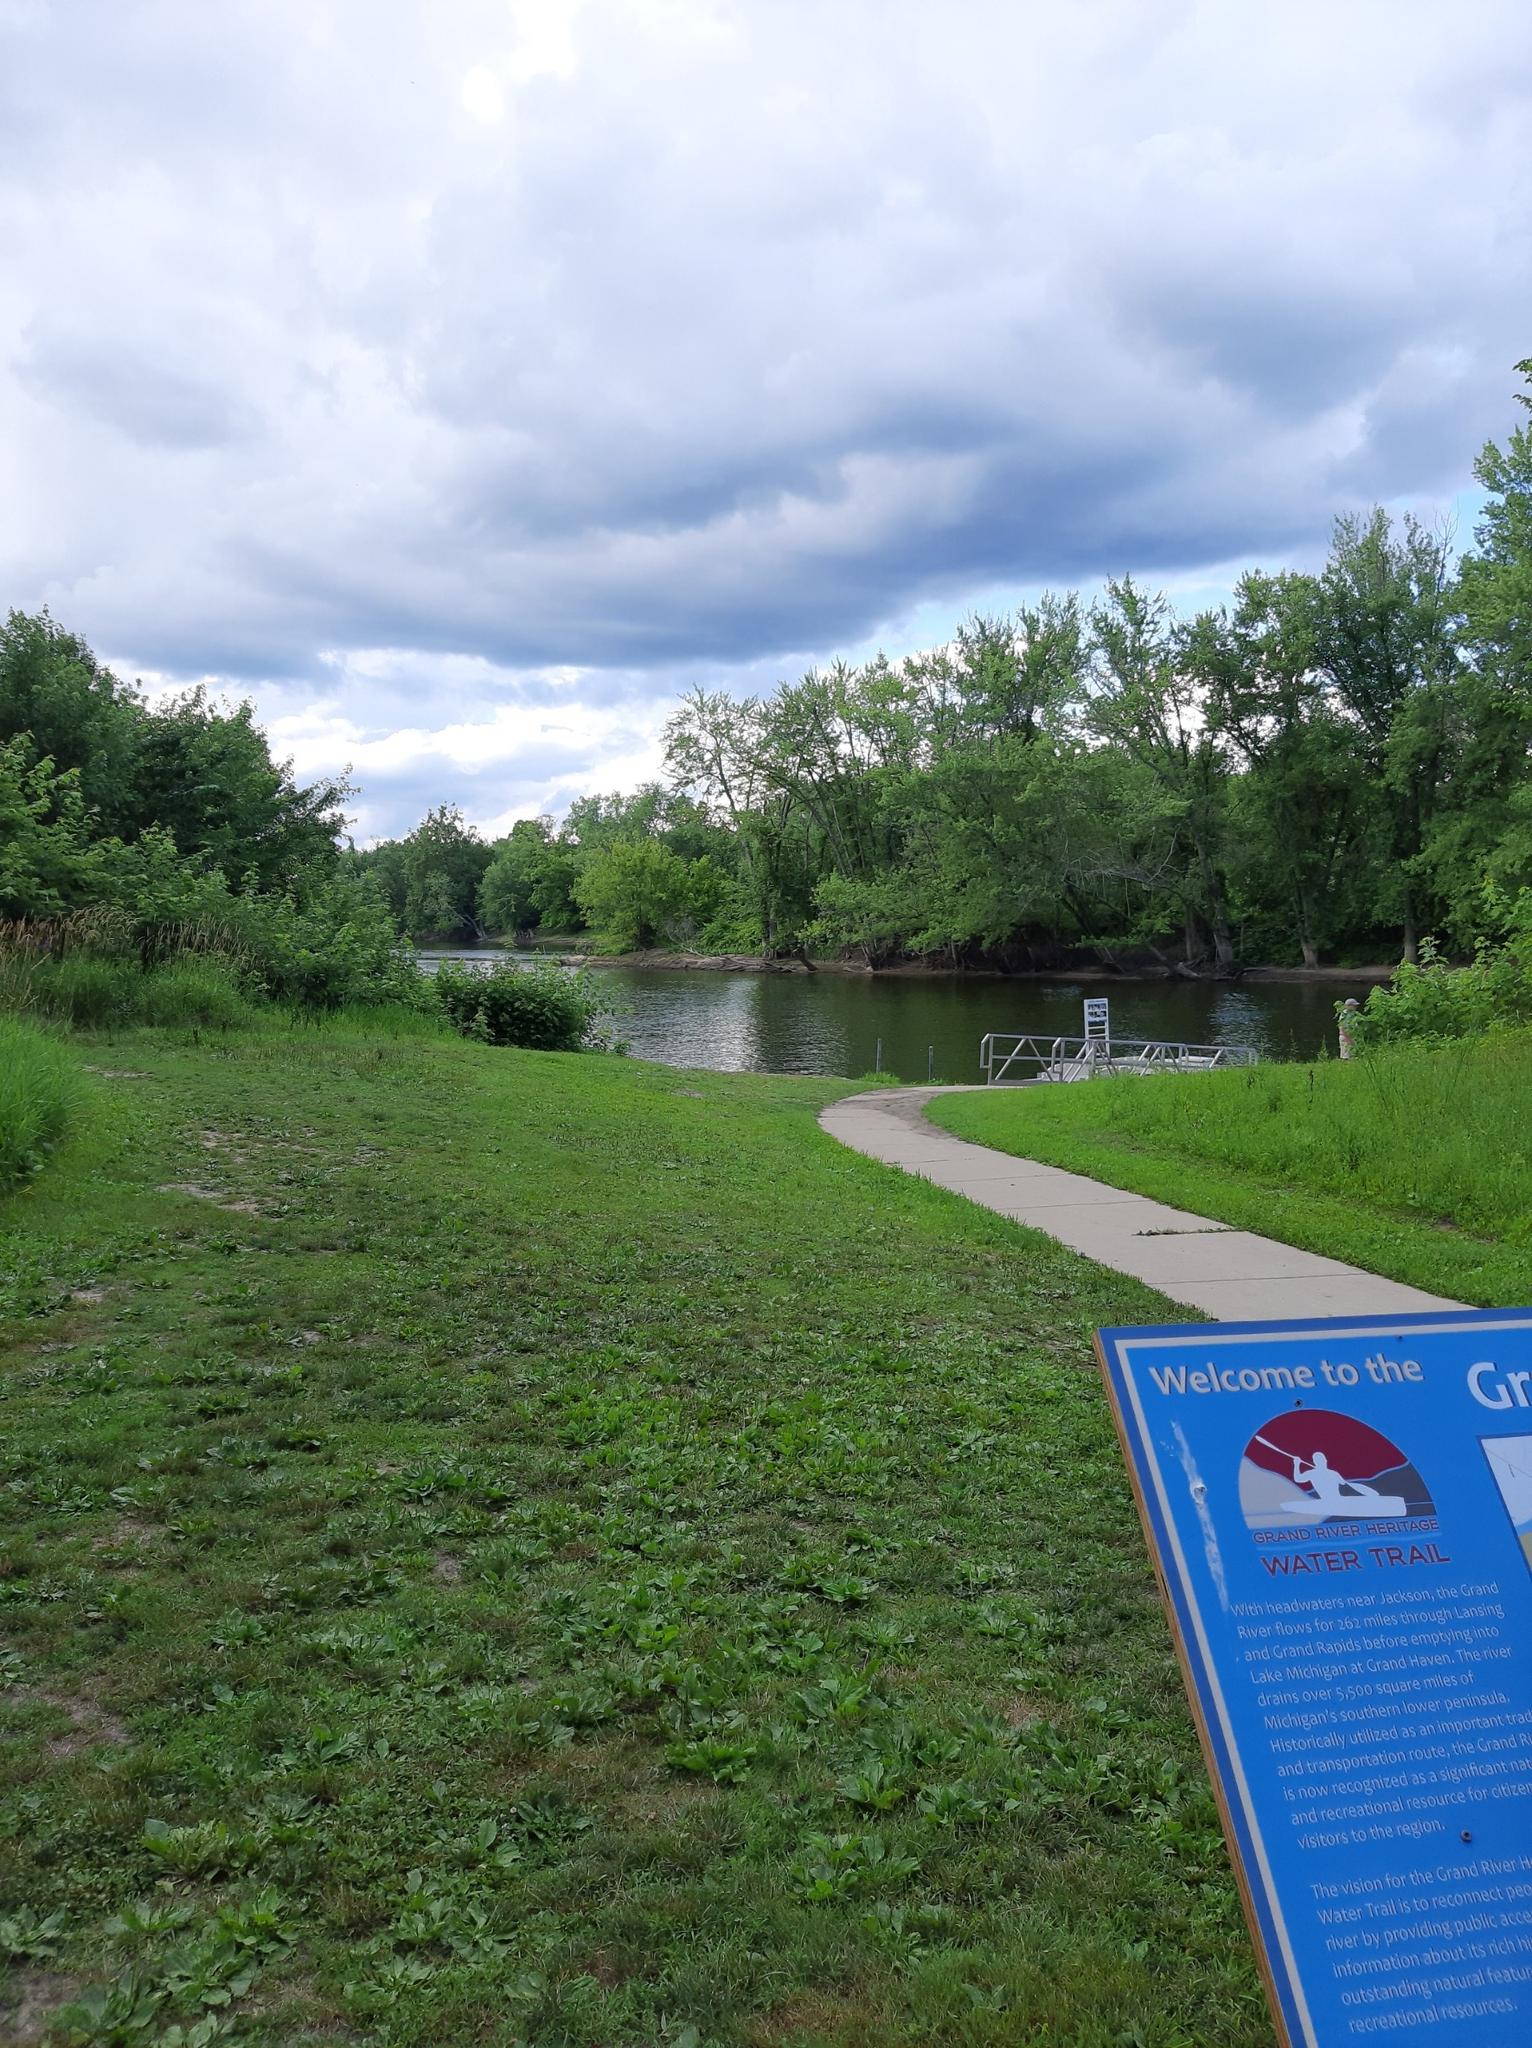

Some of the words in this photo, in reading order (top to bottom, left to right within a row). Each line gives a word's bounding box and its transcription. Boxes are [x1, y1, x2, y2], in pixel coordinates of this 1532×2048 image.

[1149, 1362, 1316, 1395] Welcome
[1321, 1360, 1359, 1386] to
[1366, 1353, 1424, 1384] the
[1467, 1361, 1532, 1409] Gr
[1253, 1529, 1310, 1543] GRAND
[1315, 1524, 1360, 1539] RIVER
[1367, 1518, 1440, 1535] HERITAGE
[1260, 1551, 1363, 1577] WATER
[1369, 1543, 1450, 1568] TRAIL
[1230, 1602, 1265, 1615] With
[1266, 1598, 1344, 1613] headwaters
[1347, 1596, 1375, 1606] near
[1381, 1589, 1435, 1604] Jackson,
[1436, 1586, 1458, 1599] the
[1461, 1582, 1499, 1596] Grand
[1237, 1626, 1272, 1638] River
[1275, 1622, 1312, 1635] flows
[1315, 1618, 1333, 1631] for
[1338, 1617, 1360, 1629] 262
[1364, 1615, 1400, 1626] miles
[1400, 1608, 1452, 1624] through
[1455, 1604, 1504, 1619] Lansing
[1245, 1645, 1270, 1661] and
[1273, 1642, 1314, 1658] Grand
[1317, 1640, 1361, 1656] Rapids
[1363, 1635, 1408, 1649] before
[1411, 1630, 1472, 1646] emptying
[1473, 1627, 1499, 1638] into
[1251, 1669, 1283, 1683] Lake
[1286, 1664, 1349, 1680] Michigan
[1351, 1663, 1364, 1673] at
[1367, 1656, 1407, 1671] Grand
[1409, 1655, 1454, 1666] Haven.
[1457, 1648, 1483, 1661] The
[1484, 1647, 1511, 1658] river
[1258, 1692, 1299, 1706] drains
[1303, 1690, 1331, 1701] over
[1336, 1685, 1374, 1701] 5,500
[1376, 1680, 1422, 1696] square
[1423, 1674, 1457, 1688] miles
[1460, 1669, 1473, 1684] of
[1264, 1709, 1337, 1730] Michigan's
[1341, 1703, 1402, 1721] southern
[1402, 1700, 1440, 1713] lower
[1445, 1691, 1510, 1711] peninsula.
[1271, 1732, 1344, 1752] Historically
[1350, 1726, 1398, 1744] utilized
[1402, 1727, 1416, 1737] as
[1420, 1725, 1438, 1735] an
[1438, 1717, 1504, 1733] important
[1278, 1760, 1306, 1776] and
[1306, 1752, 1406, 1773] transportation
[1409, 1747, 1450, 1760] route,
[1452, 1742, 1476, 1754] the
[1477, 1736, 1517, 1751] Grand
[1283, 1787, 1295, 1800] is
[1298, 1786, 1328, 1798] now
[1332, 1773, 1408, 1795] recognized
[1411, 1773, 1426, 1784] as
[1430, 1772, 1439, 1782] a
[1440, 1762, 1508, 1783] significant
[1291, 1808, 1319, 1825] and
[1321, 1798, 1403, 1820] recreational
[1407, 1792, 1467, 1808] resource
[1467, 1787, 1488, 1800] for
[1297, 1833, 1348, 1848] visitors
[1351, 1829, 1368, 1841] to
[1370, 1825, 1393, 1839] the
[1397, 1819, 1447, 1838] region.
[1310, 1882, 1339, 1898] The
[1340, 1879, 1383, 1893] vision
[1385, 1872, 1406, 1887] for
[1409, 1869, 1434, 1885] the
[1436, 1862, 1478, 1881] Grand
[1481, 1859, 1516, 1874] River
[1317, 1908, 1362, 1924] Water
[1365, 1901, 1396, 1916] Trail
[1399, 1899, 1410, 1912] is
[1413, 1899, 1430, 1911] to
[1432, 1887, 1503, 1907] reconnect
[1326, 1936, 1358, 1950] river
[1362, 1931, 1379, 1948] by
[1384, 1921, 1455, 1945] providing
[1454, 1914, 1497, 1935] public
[1333, 1955, 1422, 1977] information
[1423, 1948, 1466, 1964] about
[1467, 1944, 1485, 1957] its
[1489, 1937, 1517, 1953] rich
[1341, 1979, 1432, 2005] outstanding
[1433, 1969, 1485, 1990] natural
[1349, 2007, 1442, 2032] recreational
[1441, 1998, 1517, 2018] resources.
